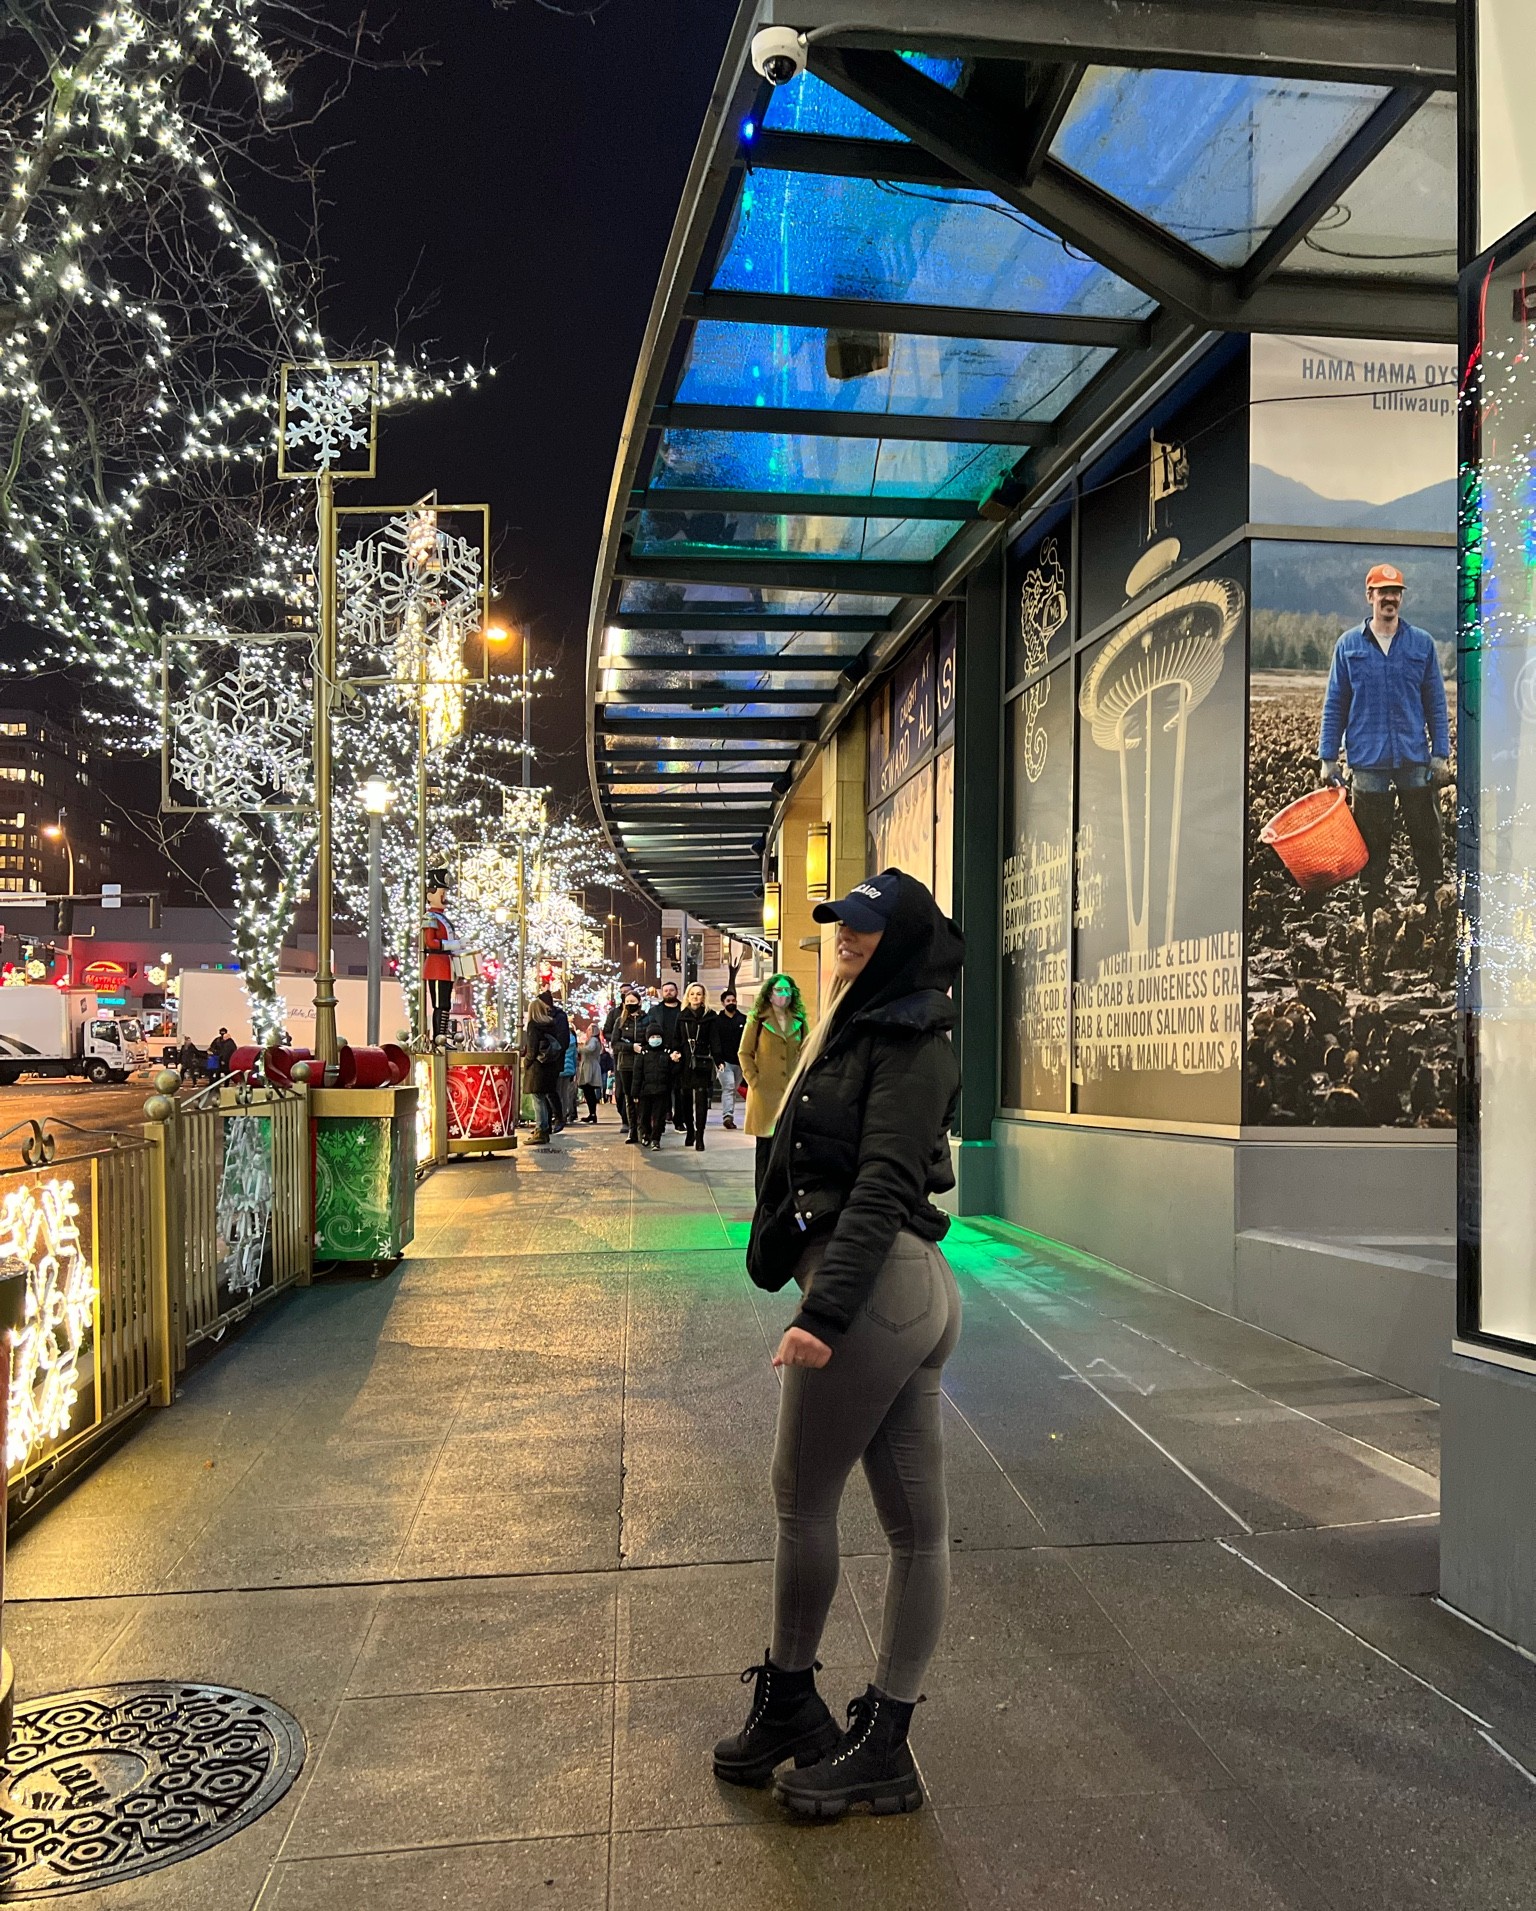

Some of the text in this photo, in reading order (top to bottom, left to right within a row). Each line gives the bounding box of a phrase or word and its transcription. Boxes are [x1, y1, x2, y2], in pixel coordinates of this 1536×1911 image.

[1302, 358, 1356, 382] HAMA
[1364, 361, 1417, 385] HAMA
[1372, 391, 1456, 417] Lilliwaup,
[1043, 988, 1060, 1012] COD
[1072, 985, 1094, 1010] KING
[1097, 980, 1124, 1009] CRAB
[1127, 979, 1135, 1006] &
[1138, 970, 1208, 1005] DUNGENESS
[1096, 1014, 1103, 1039] &
[1106, 1010, 1153, 1038] CHINOOK
[1156, 1006, 1205, 1036] SALMON
[1210, 1004, 1219, 1033] &
[1137, 1041, 1179, 1070] MANILA
[1182, 1040, 1225, 1070] CLAMS
